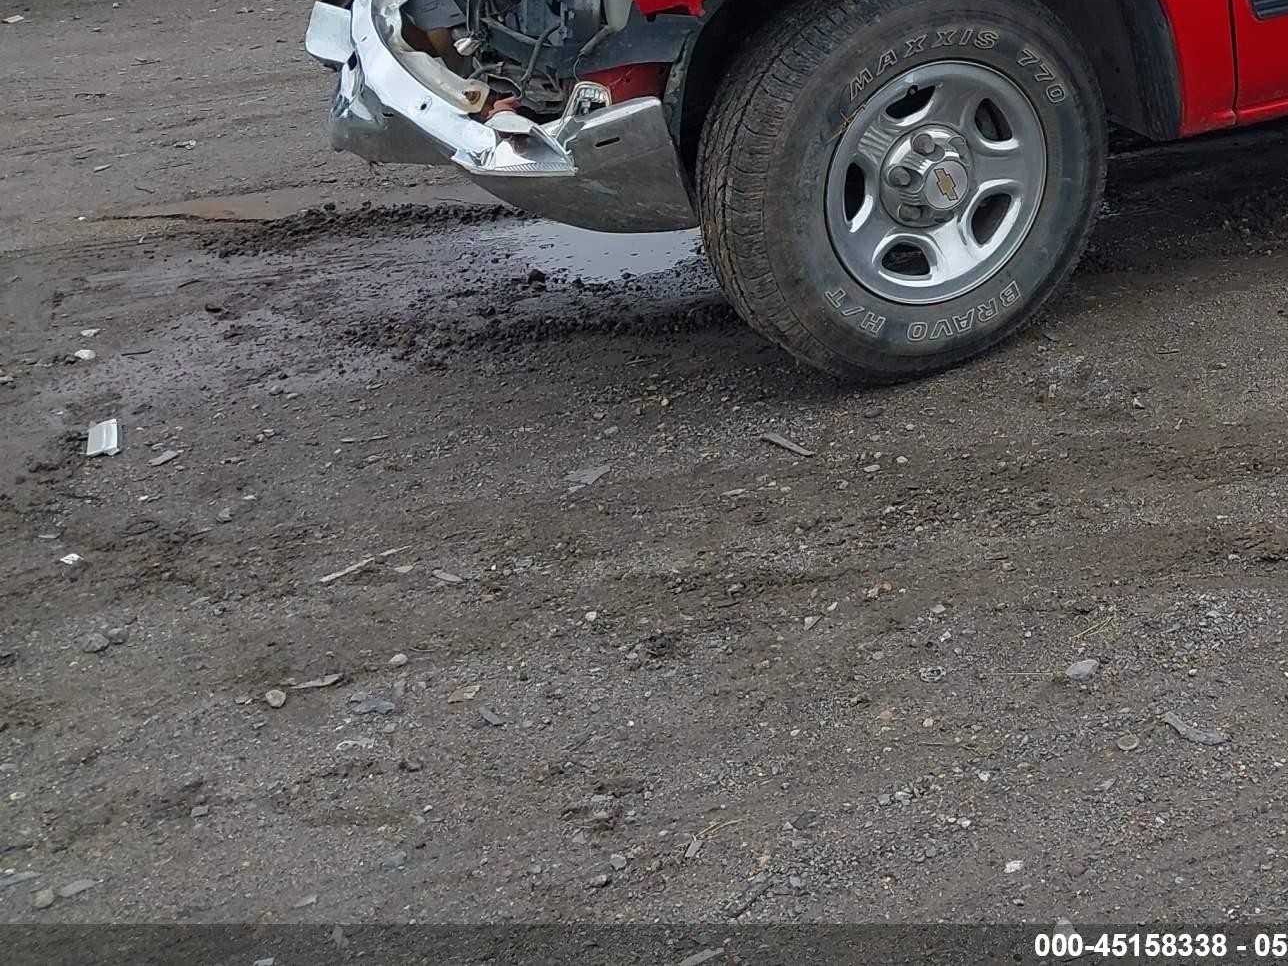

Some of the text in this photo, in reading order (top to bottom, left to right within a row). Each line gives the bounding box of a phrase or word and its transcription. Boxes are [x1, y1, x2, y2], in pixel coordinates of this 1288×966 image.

[848, 28, 1066, 105] MAXXIS 770
[824, 280, 1023, 342] BRAVO H/T
